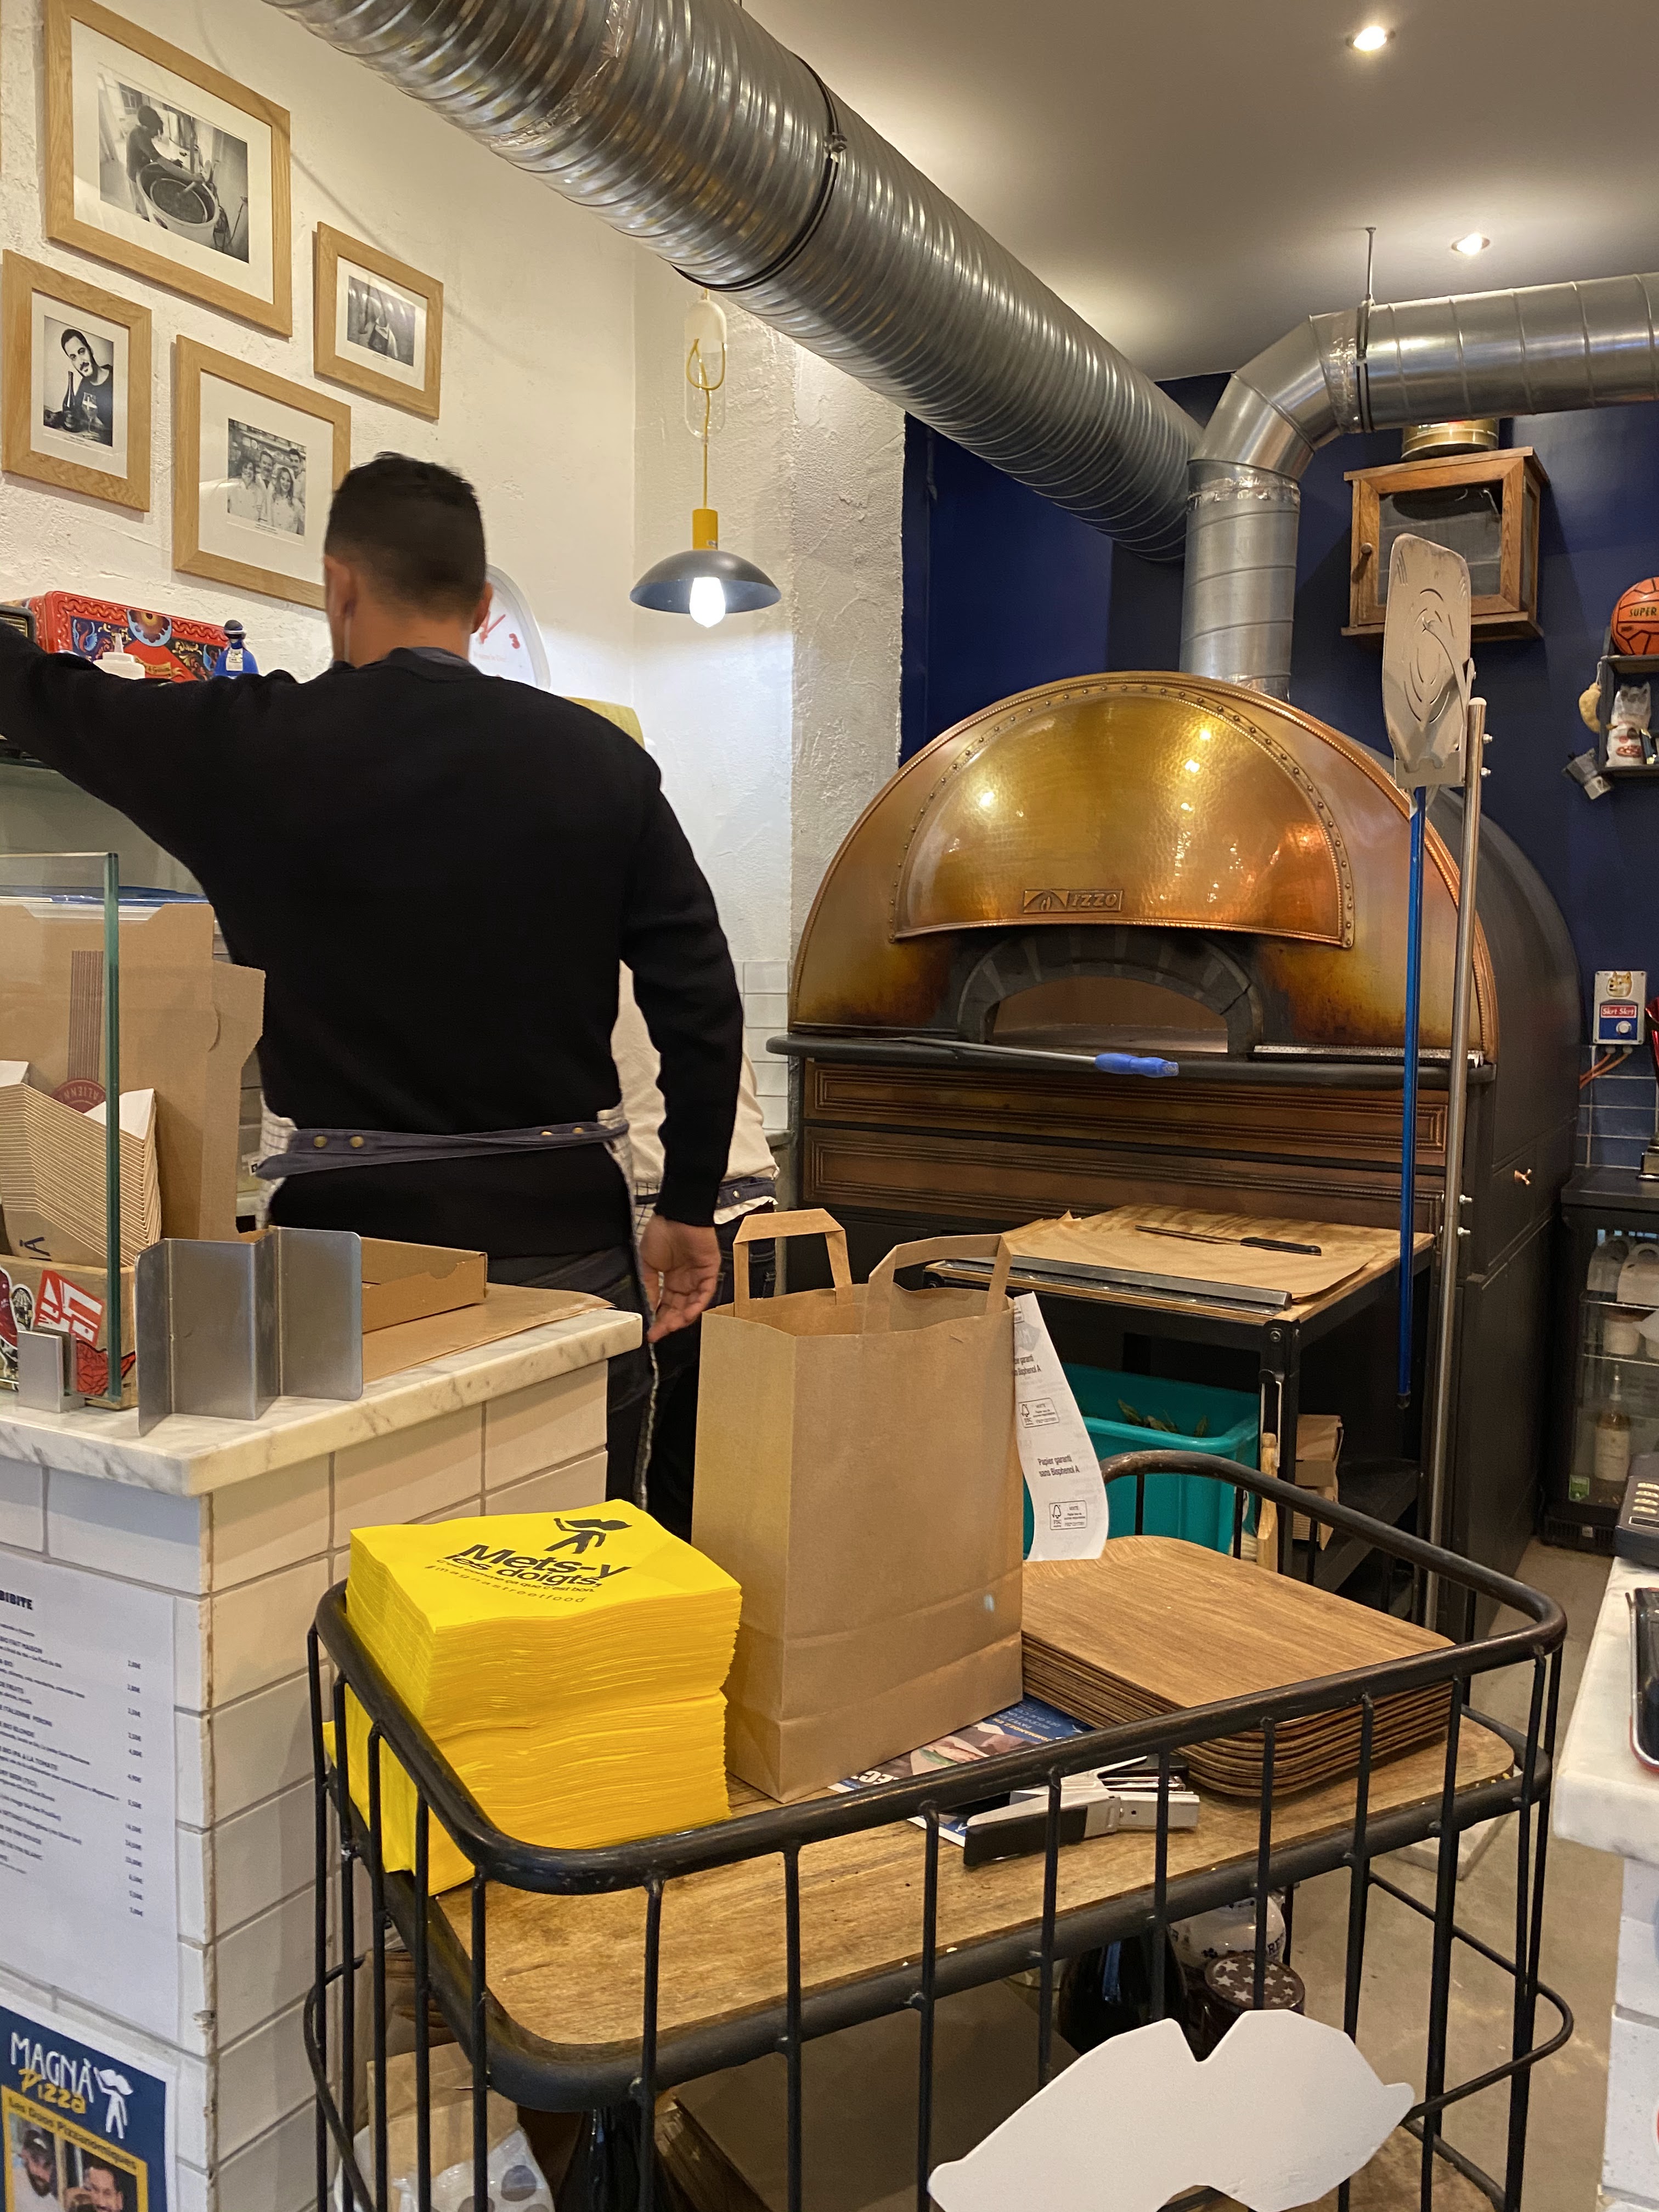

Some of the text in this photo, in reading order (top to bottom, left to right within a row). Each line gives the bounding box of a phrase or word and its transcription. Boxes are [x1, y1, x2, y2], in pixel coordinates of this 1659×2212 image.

[1629, 607, 1657, 617] SUPER
[509, 633, 521, 649] 3
[1071, 894, 1117, 907] IZZO
[1037, 1454, 1073, 1466] Papier garanti
[1051, 1465, 1075, 1476] Bisphenol
[458, 1544, 632, 1578] Mets-y
[443, 1554, 602, 1588] les doigts,
[425, 1565, 586, 1602] #magnastreetfood
[11, 2032, 94, 2103] MAGNÀ
